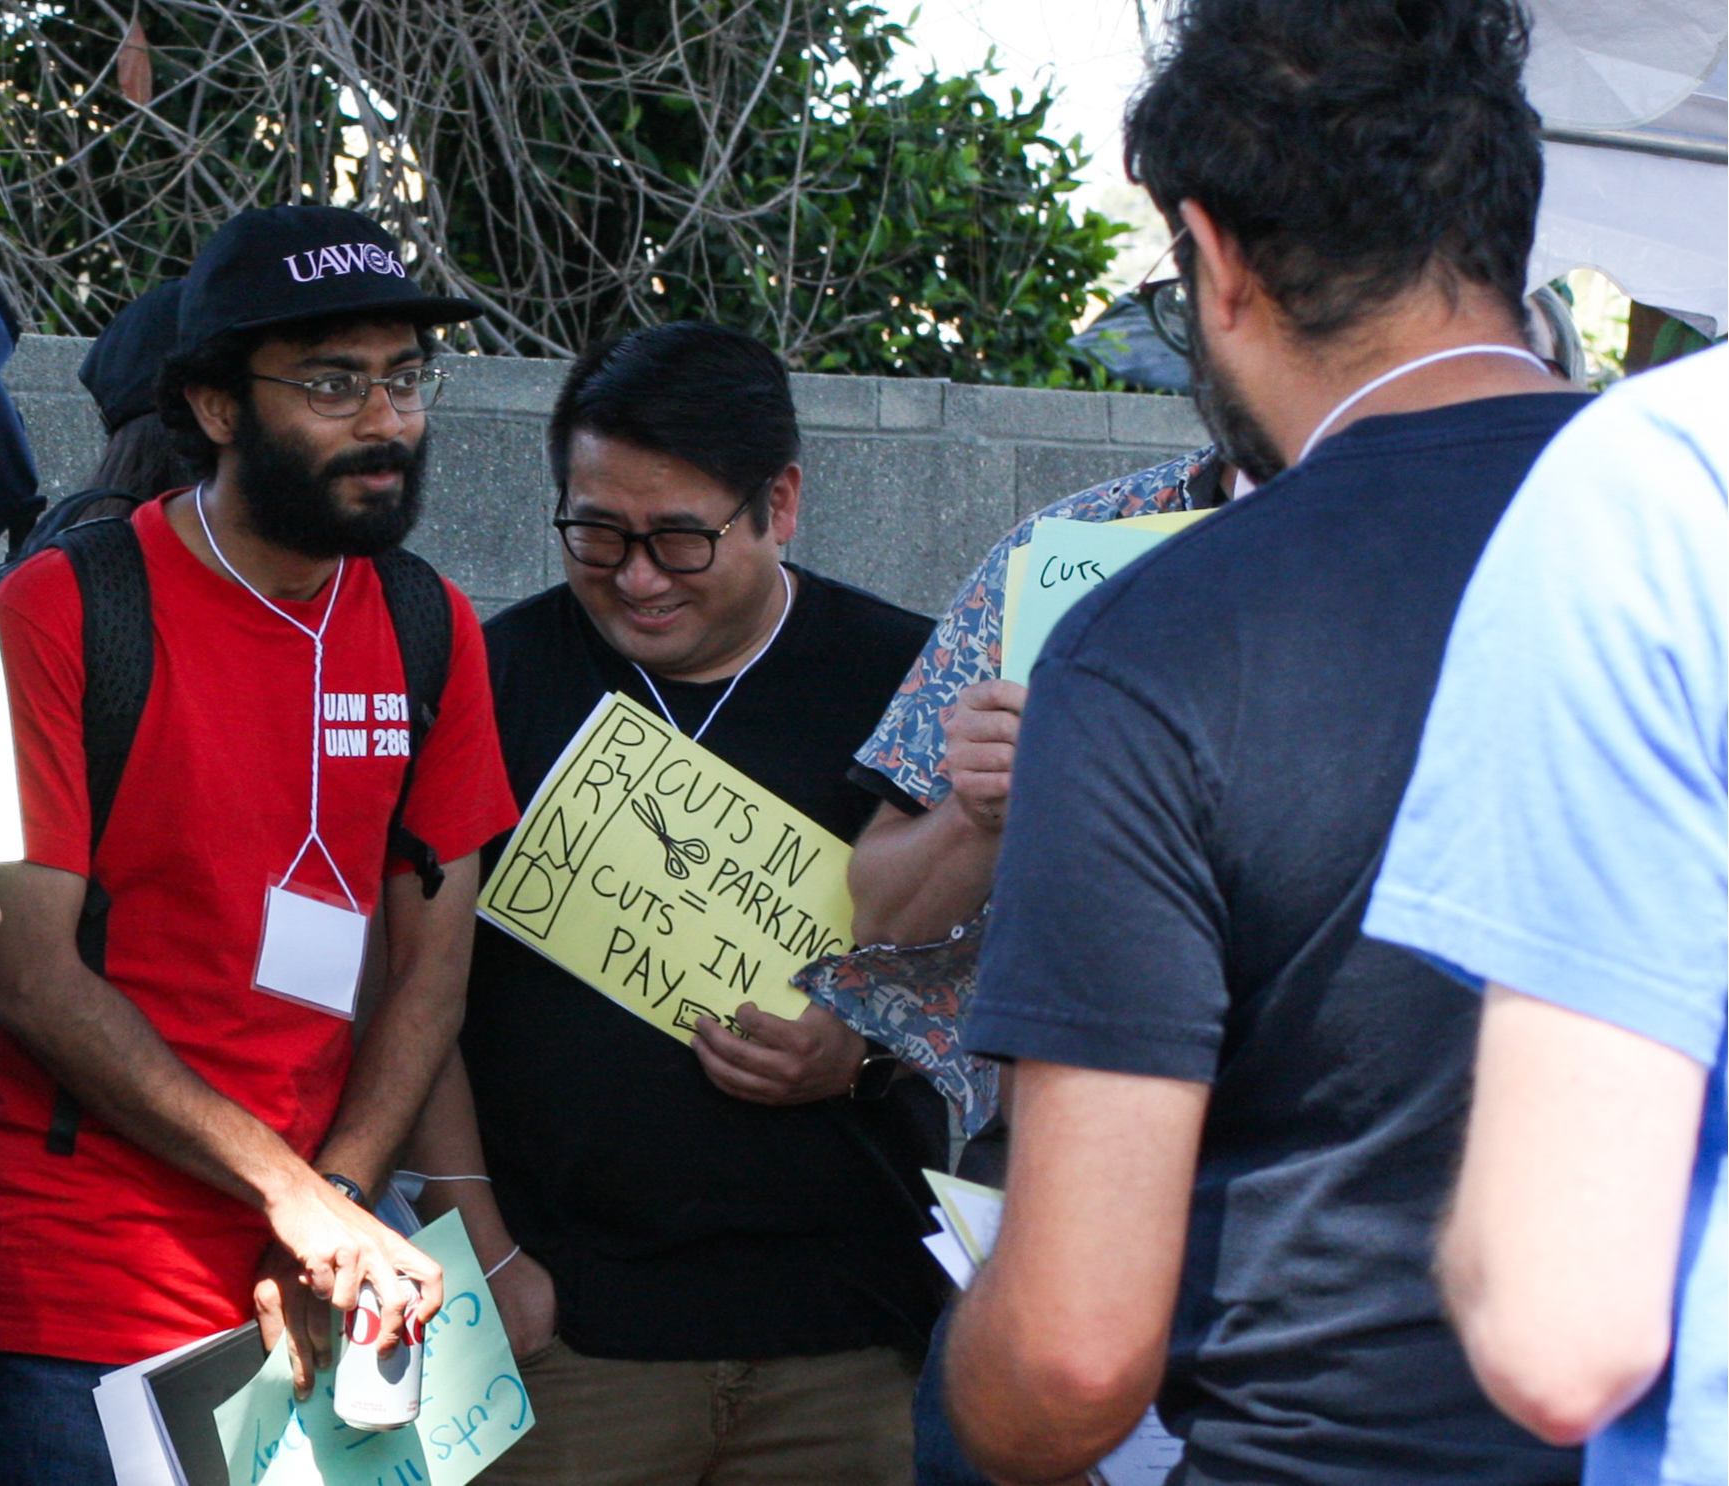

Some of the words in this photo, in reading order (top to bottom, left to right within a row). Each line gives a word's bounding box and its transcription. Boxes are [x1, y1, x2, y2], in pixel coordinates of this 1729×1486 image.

[323, 693, 367, 722] UAW
[324, 728, 368, 757] UAW
[655, 758, 760, 845] CUTS
[760, 822, 822, 888] IN
[591, 864, 676, 936] CUTS
[699, 934, 762, 995] IN
[600, 925, 687, 1010] PAY
